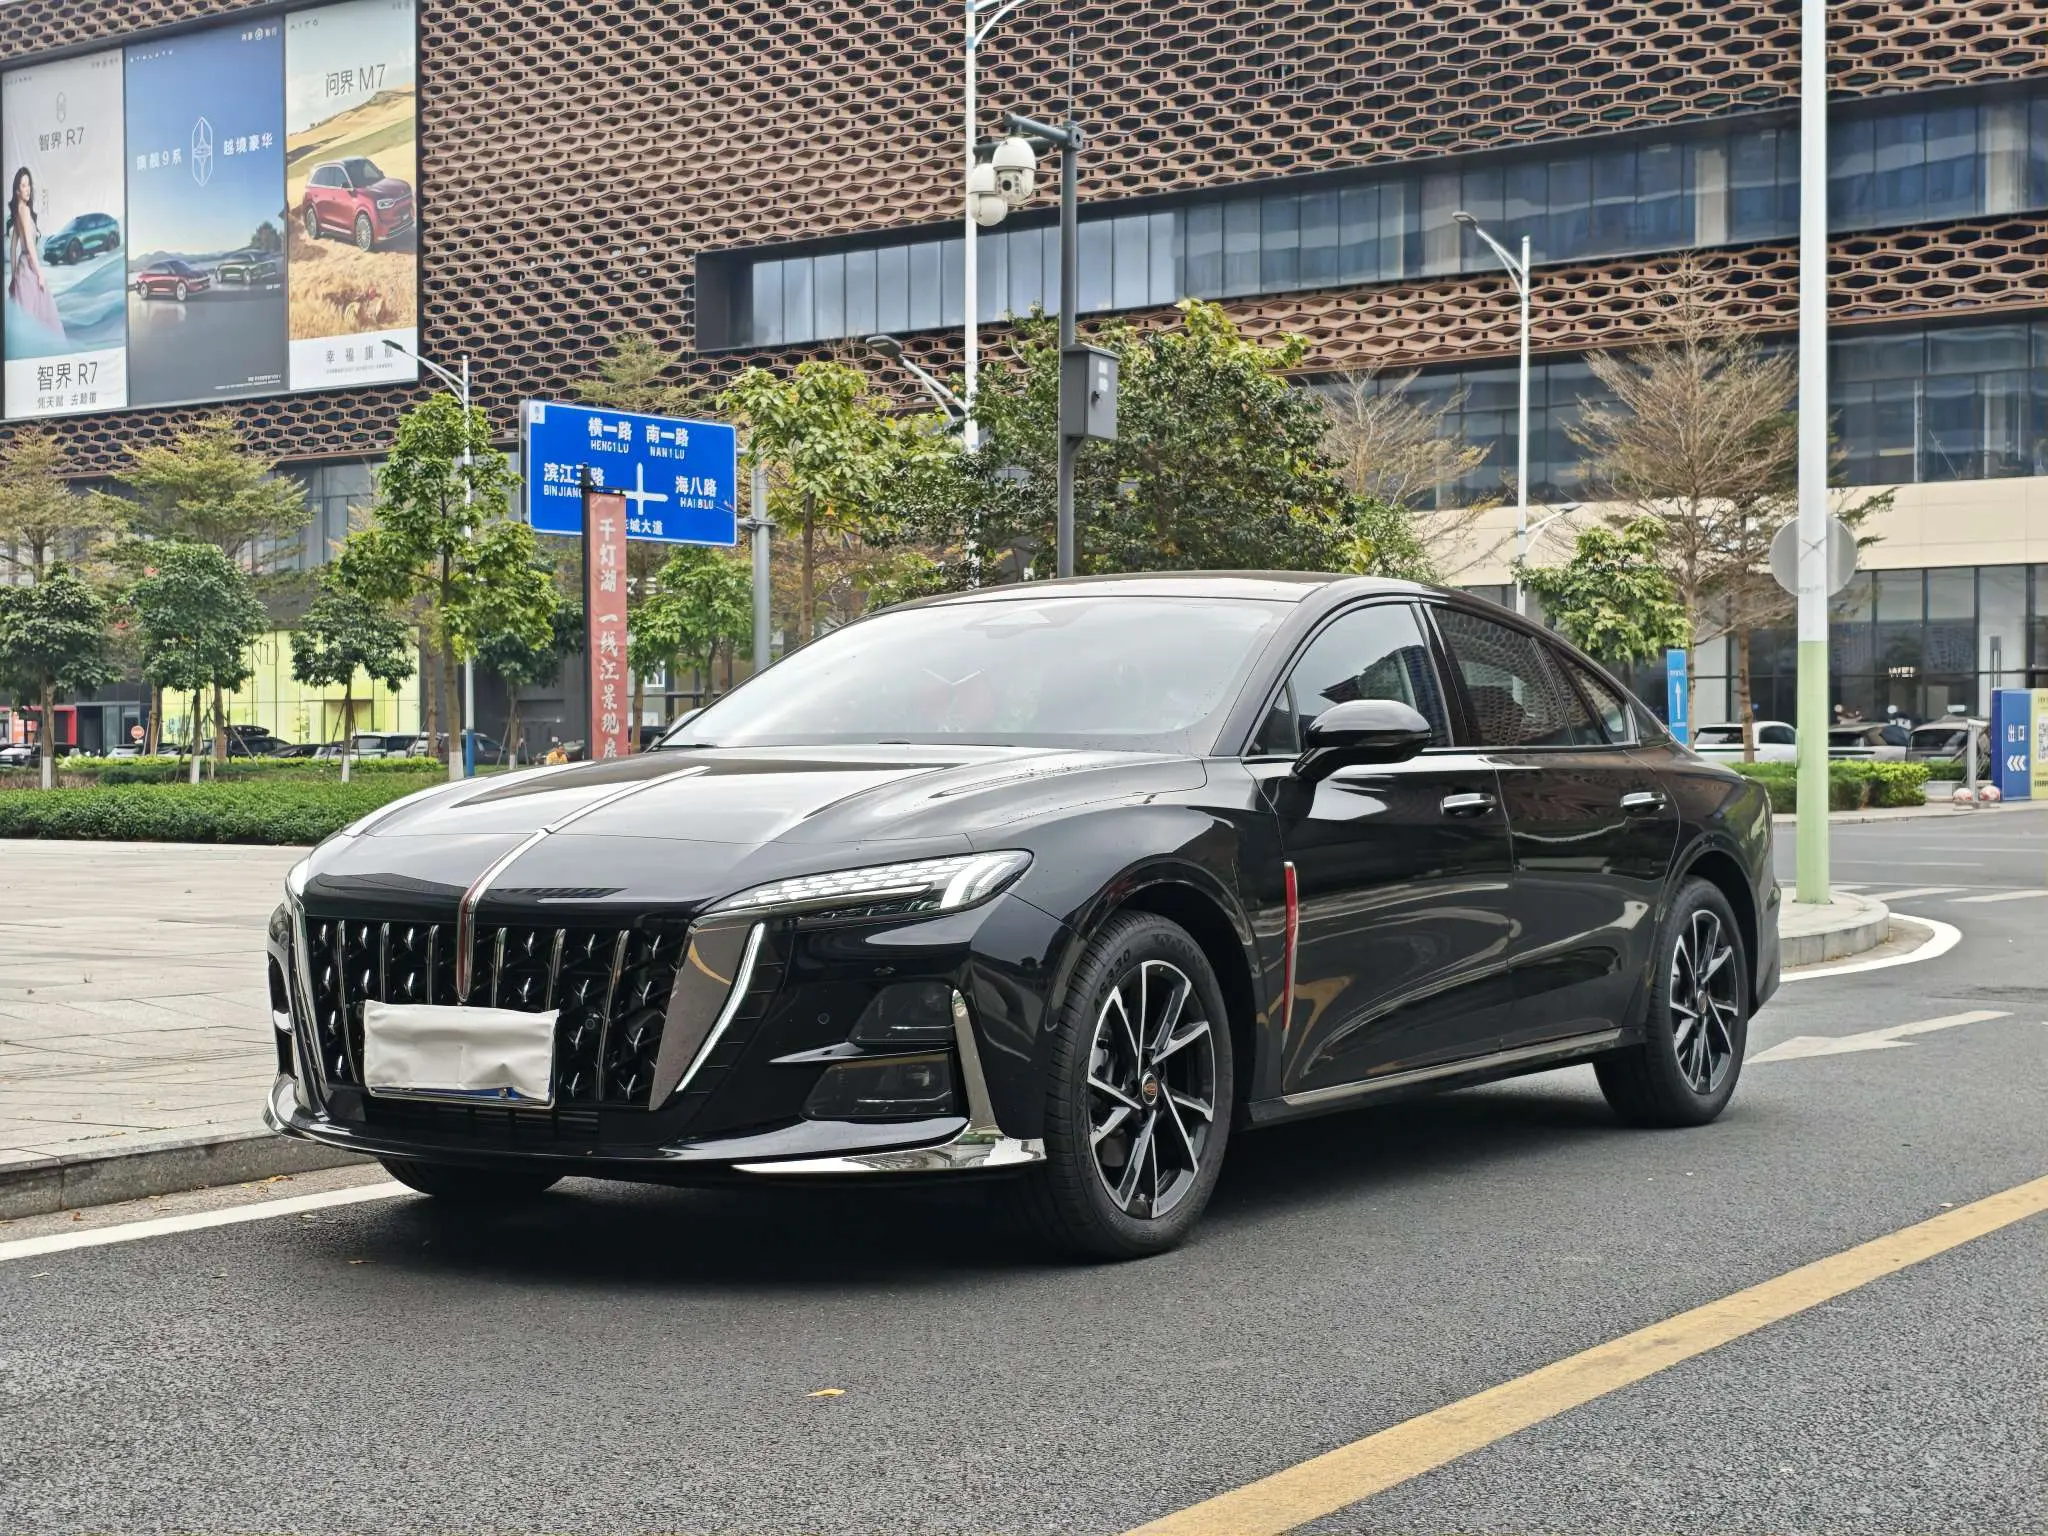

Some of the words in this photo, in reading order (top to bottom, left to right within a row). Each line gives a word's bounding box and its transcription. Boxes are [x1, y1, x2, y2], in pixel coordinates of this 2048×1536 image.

[325, 69, 354, 98] 问界
[359, 63, 386, 92] M7
[66, 126, 85, 147] R7
[37, 363, 72, 392] 智界
[78, 361, 98, 385] R7
[588, 417, 632, 441] 横一路
[645, 424, 689, 448] 南一路
[674, 475, 717, 498] 海八路
[598, 518, 616, 593] 千灯湖
